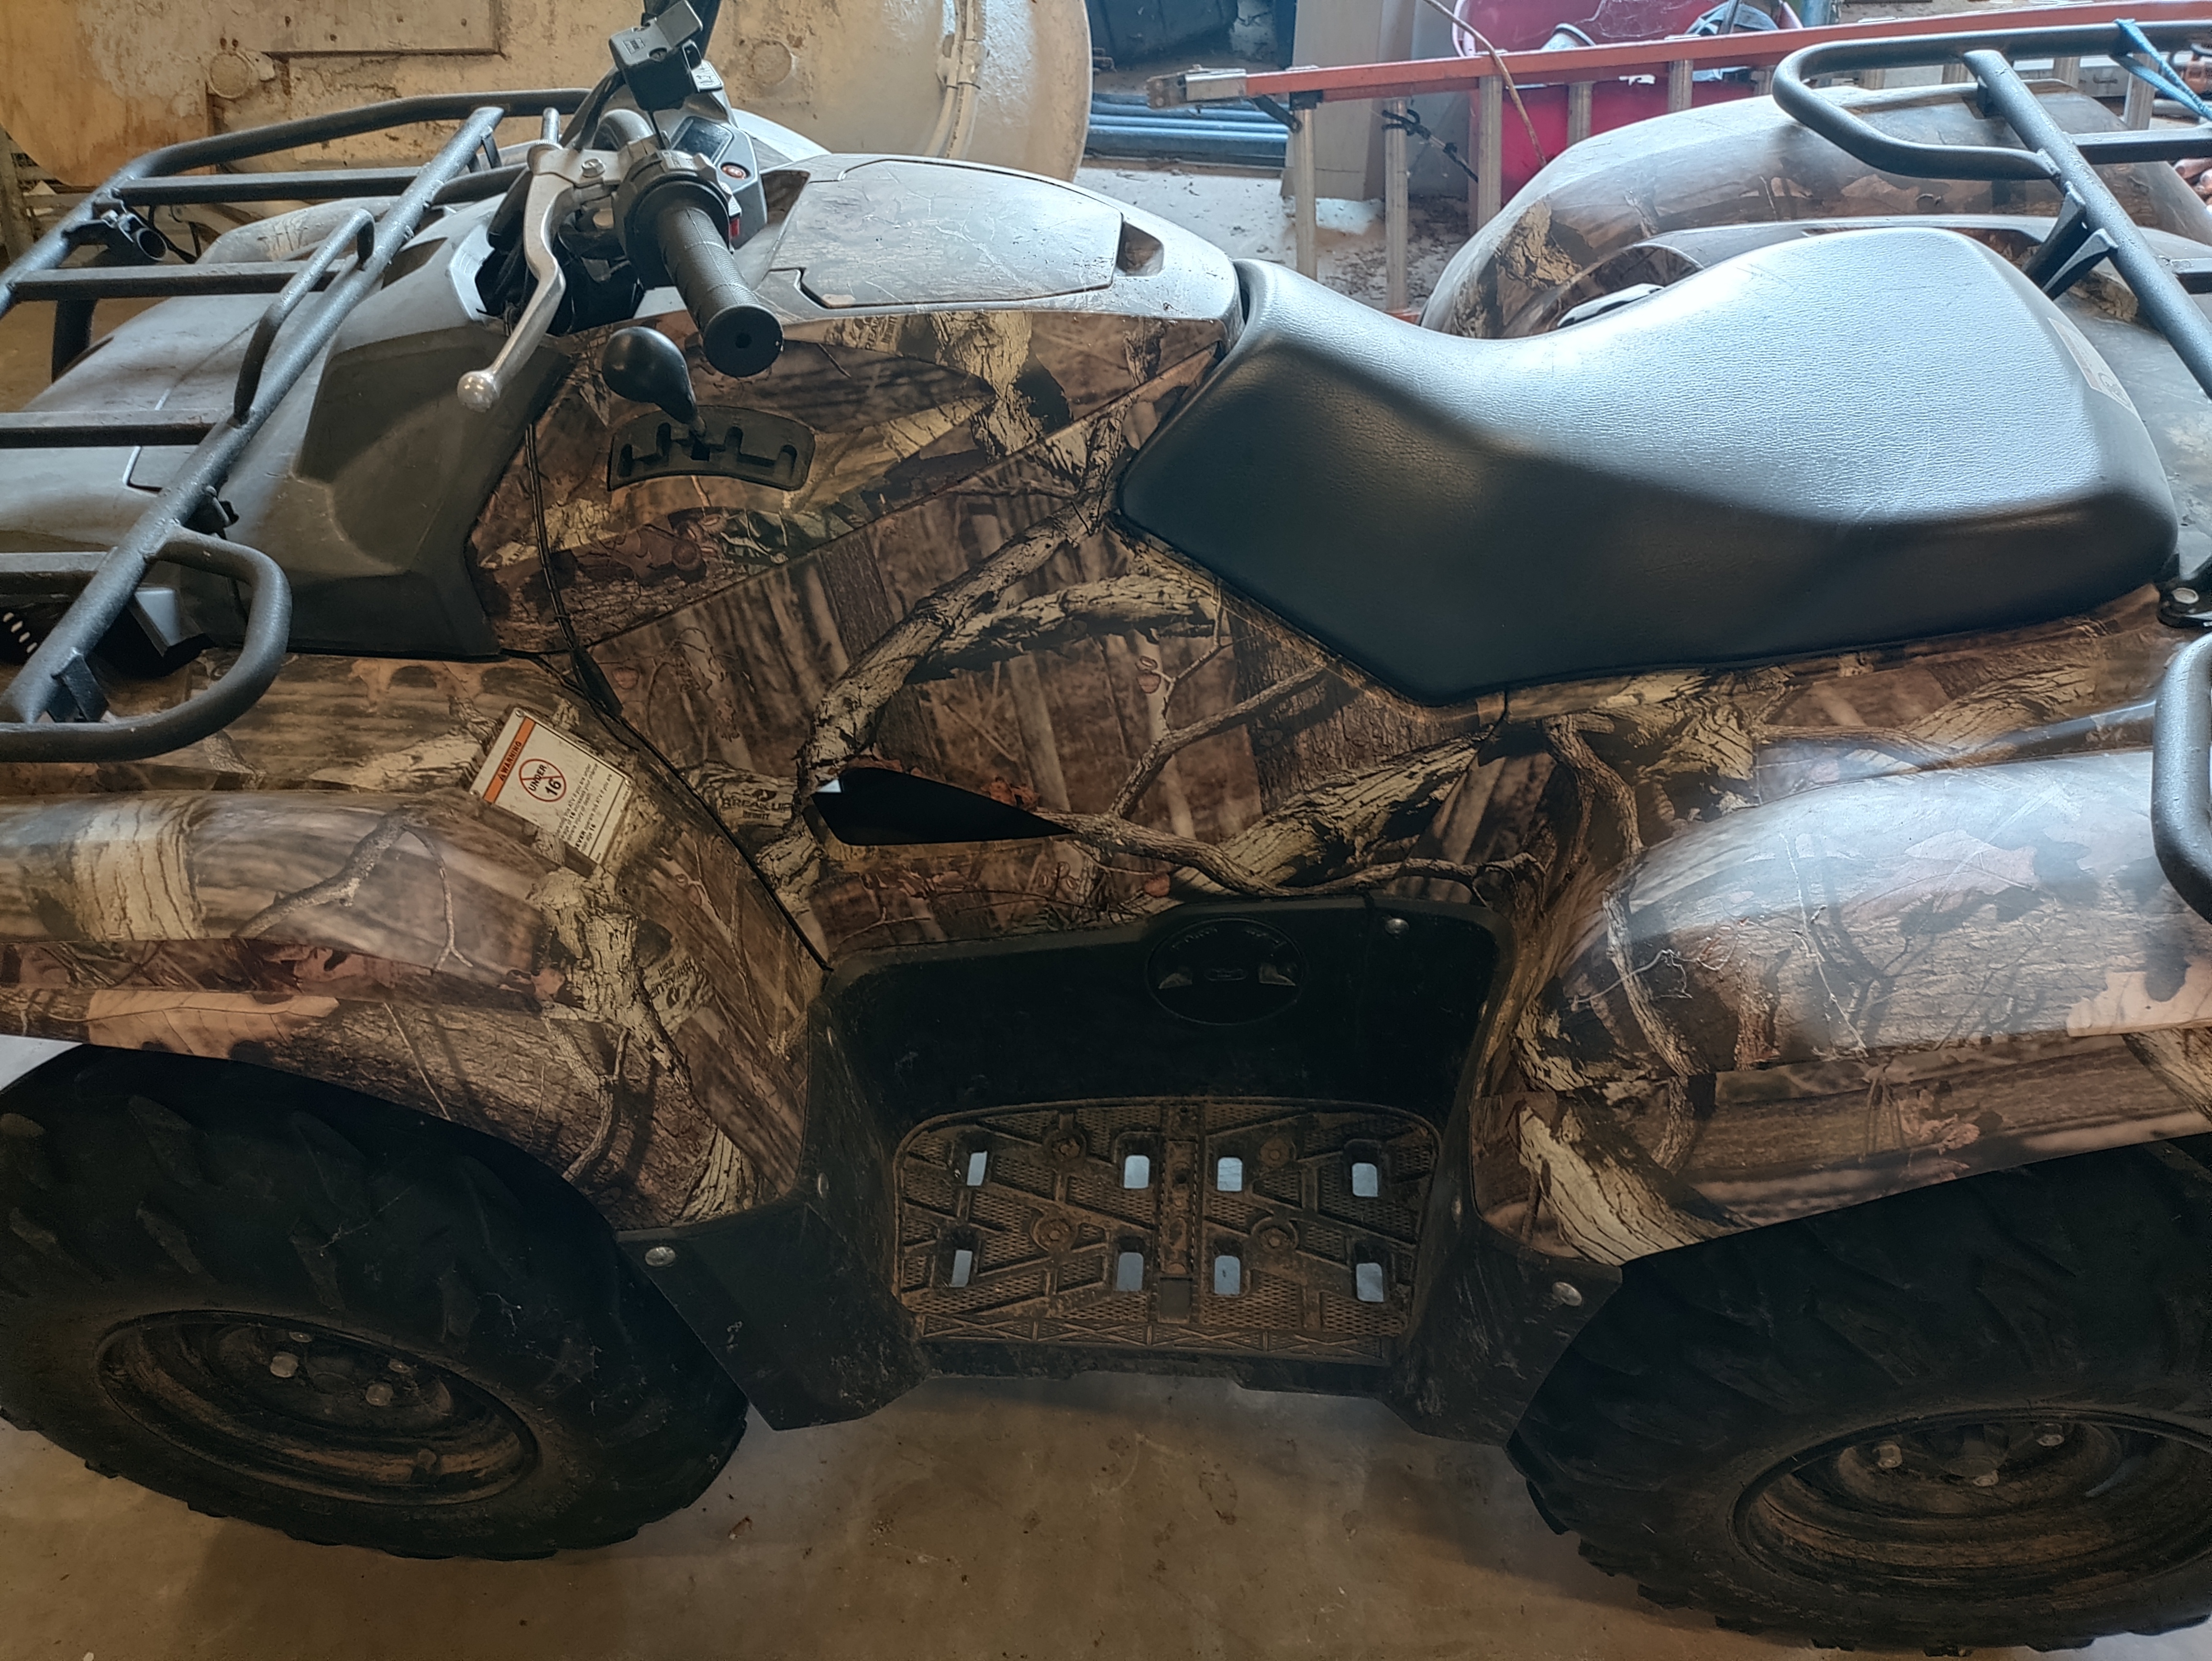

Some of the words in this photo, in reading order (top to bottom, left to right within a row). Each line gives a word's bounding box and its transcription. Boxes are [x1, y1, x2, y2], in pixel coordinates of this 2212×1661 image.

[500, 740, 522, 775] WARNING
[527, 764, 547, 792] UNDER
[543, 777, 562, 797] 16
